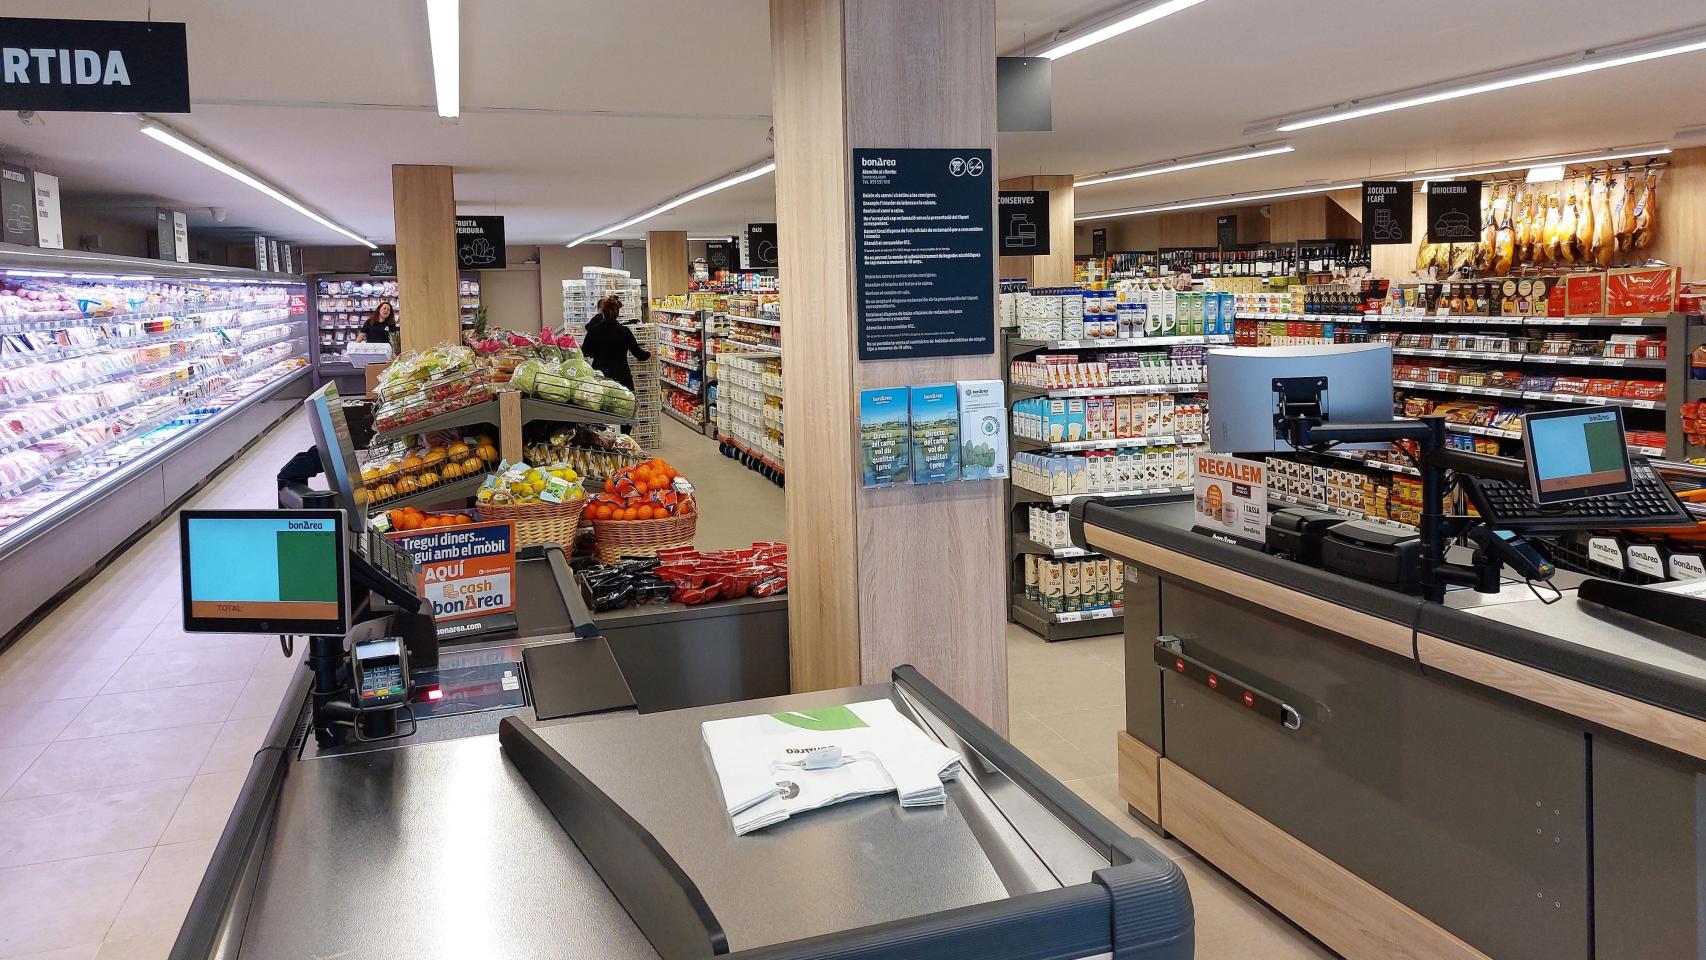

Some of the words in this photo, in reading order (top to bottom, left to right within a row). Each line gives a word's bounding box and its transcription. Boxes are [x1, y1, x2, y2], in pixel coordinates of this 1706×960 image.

[3, 48, 131, 86] RTIDA
[872, 455, 895, 464] qualitat
[925, 453, 948, 462] qualitat
[1198, 458, 1262, 484] REGALEM
[402, 534, 438, 550] Tregui
[440, 532, 485, 545] diners...
[434, 545, 459, 560] amb
[462, 543, 472, 556] el
[474, 539, 505, 555] mòbil
[425, 560, 464, 582] AQUÍ
[460, 580, 492, 595] cash
